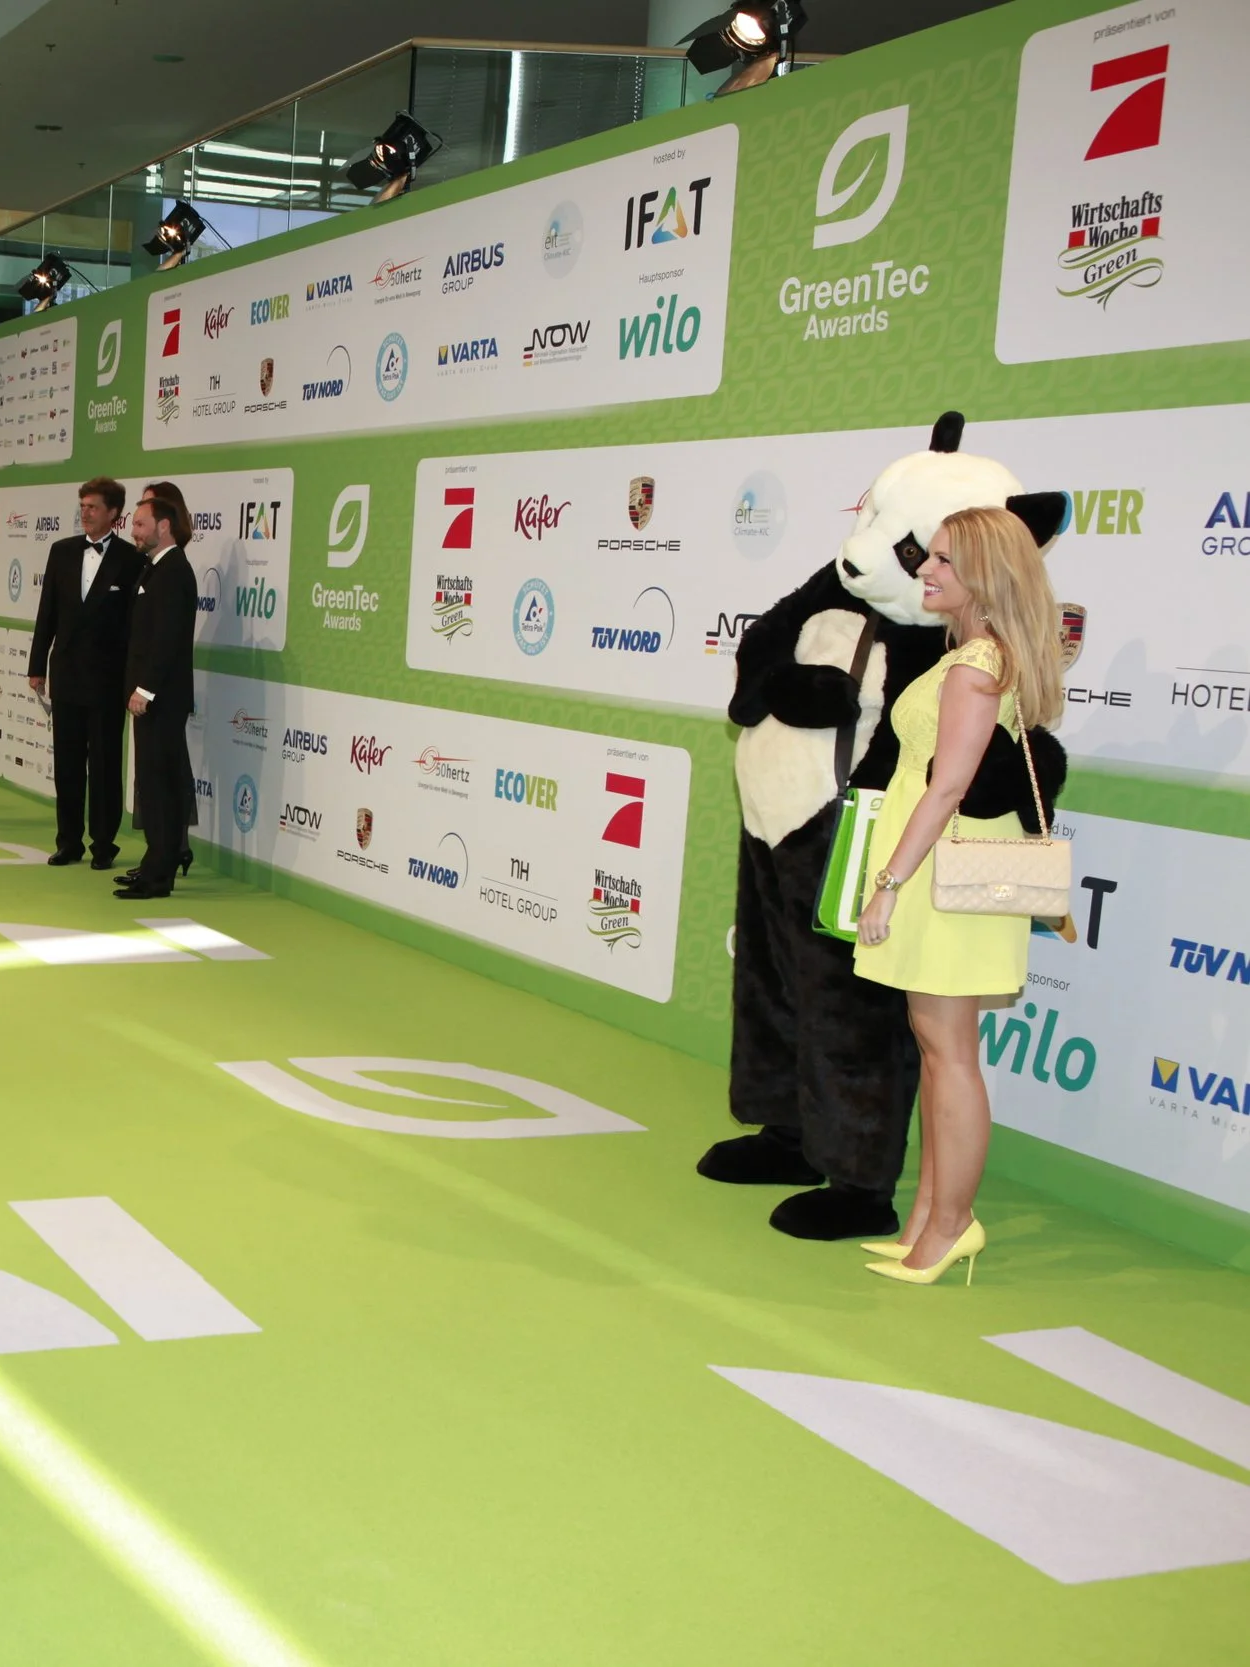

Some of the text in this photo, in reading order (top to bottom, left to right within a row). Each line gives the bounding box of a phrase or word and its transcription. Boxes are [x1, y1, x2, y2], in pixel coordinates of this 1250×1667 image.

[1093, 7, 1176, 42] präsentiert von
[653, 149, 686, 165] hosted by
[625, 177, 712, 251] IFAT
[1071, 191, 1163, 228] Wirtschafts
[1088, 222, 1139, 249] Woche
[443, 243, 505, 278] AIRBUS
[1084, 247, 1139, 285] Green
[316, 274, 353, 298] VARTA
[442, 277, 474, 295] GROUP
[639, 268, 685, 285] Hauptsponsor
[779, 260, 930, 315] GreenTec
[204, 304, 235, 340] Käfer
[251, 294, 290, 325] ECOVER
[523, 320, 590, 352] NOW
[619, 294, 701, 360] wilo
[803, 306, 889, 341] Awards
[451, 337, 498, 363] VARTA
[302, 379, 343, 401] TÜV NORD
[87, 395, 127, 419] GreenTec
[193, 400, 236, 417] HOTEL GROUP
[244, 401, 287, 413] PORSCHE
[94, 419, 117, 434] Awards
[35, 516, 60, 532] AIRBUS
[239, 501, 281, 540] IFAT
[514, 494, 571, 541] Käfer
[598, 540, 681, 551] PORSCHE
[1201, 536, 1250, 556] GRO
[436, 575, 473, 592] Wirtschafts
[236, 577, 277, 619] wilo
[312, 582, 379, 613] GreenTec
[443, 591, 463, 605] Woche
[323, 610, 362, 632] Awards
[441, 610, 464, 627] Green
[521, 623, 544, 633] Tetra Pak
[591, 627, 661, 653] TÜV NORD
[1172, 682, 1250, 713] HOTE
[282, 727, 328, 756] AIRBUS
[606, 747, 649, 761] präsentiert von
[281, 750, 305, 763] GROUP
[350, 735, 393, 775] Käfer
[435, 762, 470, 783] 50hertz
[494, 768, 558, 812] ECOVER
[280, 803, 322, 830] NOW
[1062, 824, 1076, 839] by
[336, 850, 389, 874] PORSCHE
[408, 858, 459, 889] TÜV NORD
[594, 869, 642, 898] Wirtschafts
[479, 886, 558, 923] HOTEL GROUP
[603, 889, 629, 909] Woche
[600, 916, 629, 931] Green
[1170, 938, 1230, 977] TÜV
[1027, 971, 1070, 992] sponsor
[1149, 1096, 1200, 1121] VARTA
[1211, 1115, 1250, 1134] Micr
